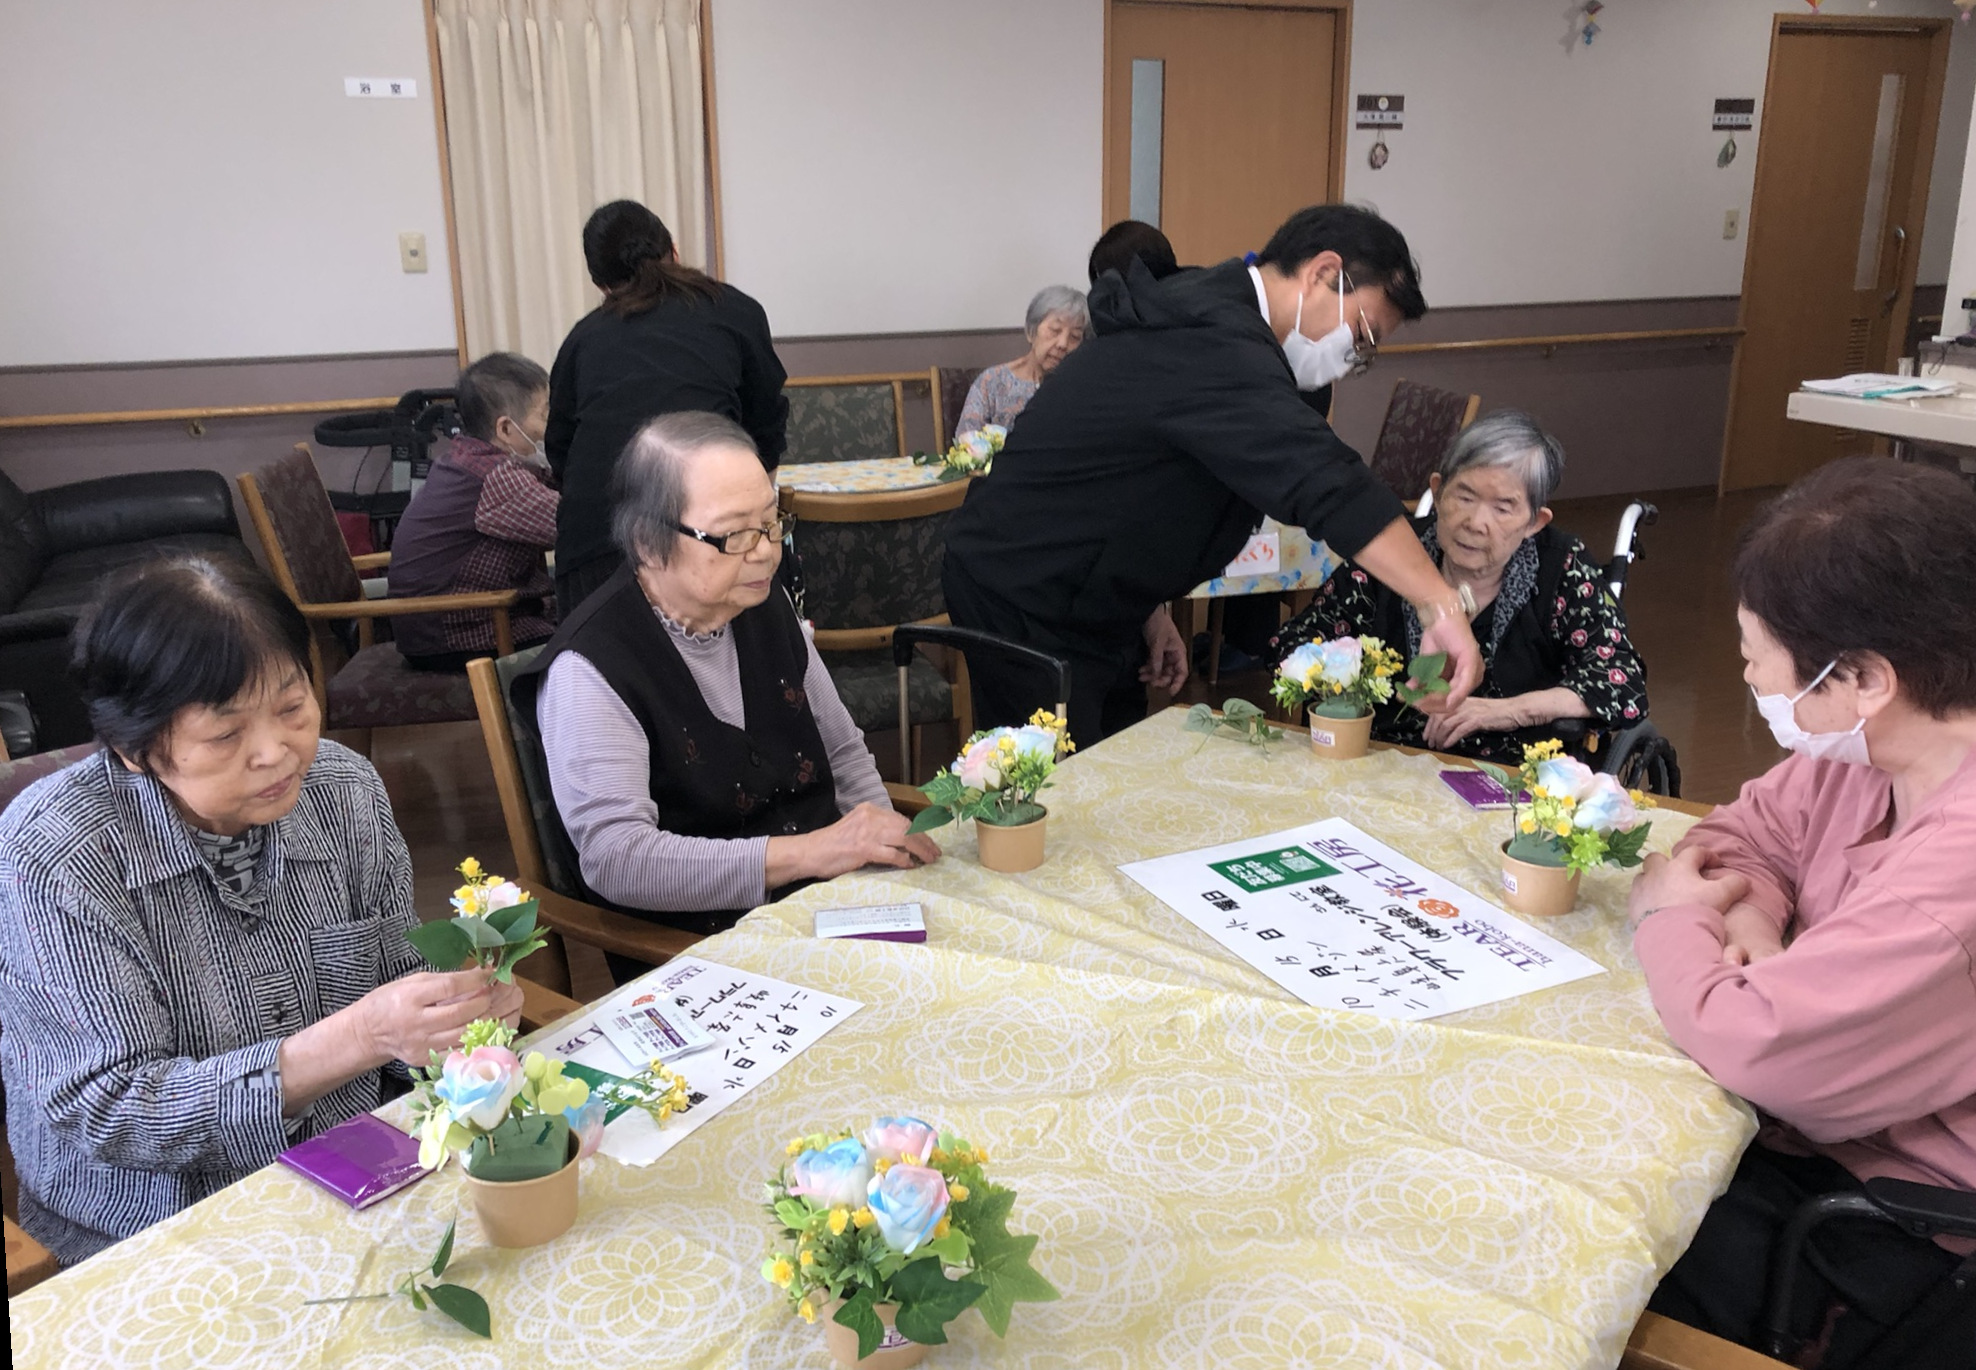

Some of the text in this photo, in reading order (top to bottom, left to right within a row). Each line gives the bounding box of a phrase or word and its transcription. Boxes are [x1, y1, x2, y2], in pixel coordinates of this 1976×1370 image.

[1306, 838, 1428, 901] 花工房
[1201, 890, 1375, 1009] 10 月 15 日 水 曜日
[1308, 884, 1465, 981] フラワーアレンジ教室
[1452, 921, 1534, 972] TEAR
[1474, 919, 1553, 965] hana-kobo
[1306, 940, 1430, 1010] ニチイメゾン
[723, 990, 808, 1061] ニチイメゾン
[776, 1024, 799, 1036] 月
[820, 1005, 838, 1018] 10
[732, 1057, 756, 1070] 日
[772, 1039, 792, 1054] 15
[723, 1076, 745, 1090] 水
